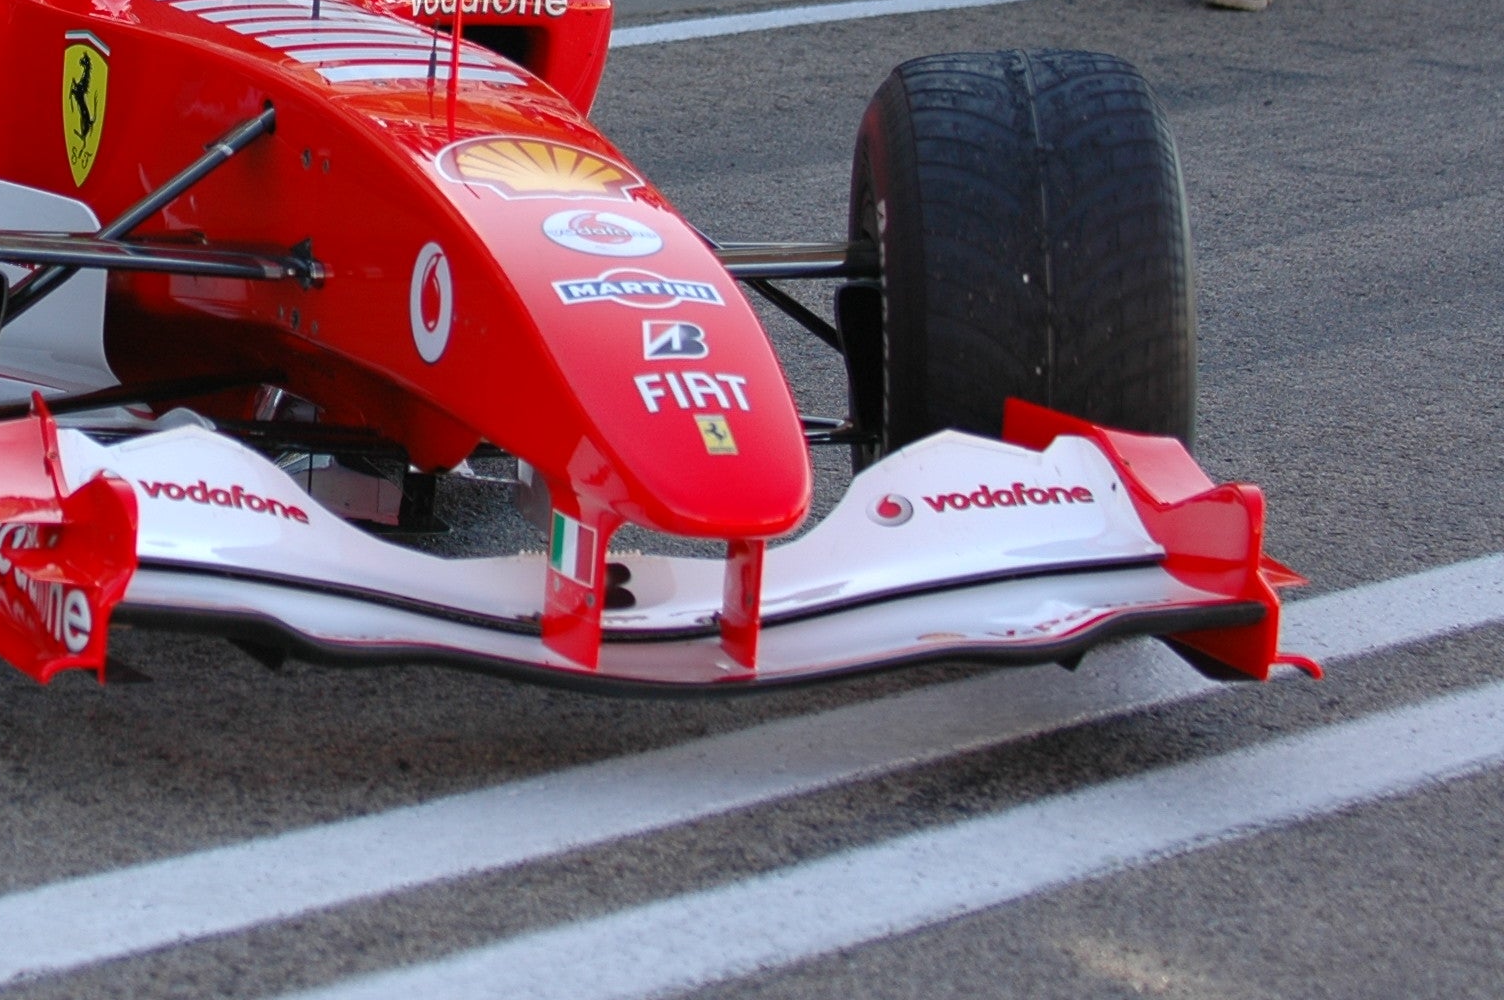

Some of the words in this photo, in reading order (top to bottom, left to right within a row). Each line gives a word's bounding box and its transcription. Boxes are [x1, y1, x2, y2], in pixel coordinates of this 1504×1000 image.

[568, 281, 710, 299] MARTINI
[634, 371, 750, 413] FIAT
[138, 479, 311, 525] vodafone
[922, 480, 1094, 514] vodafone
